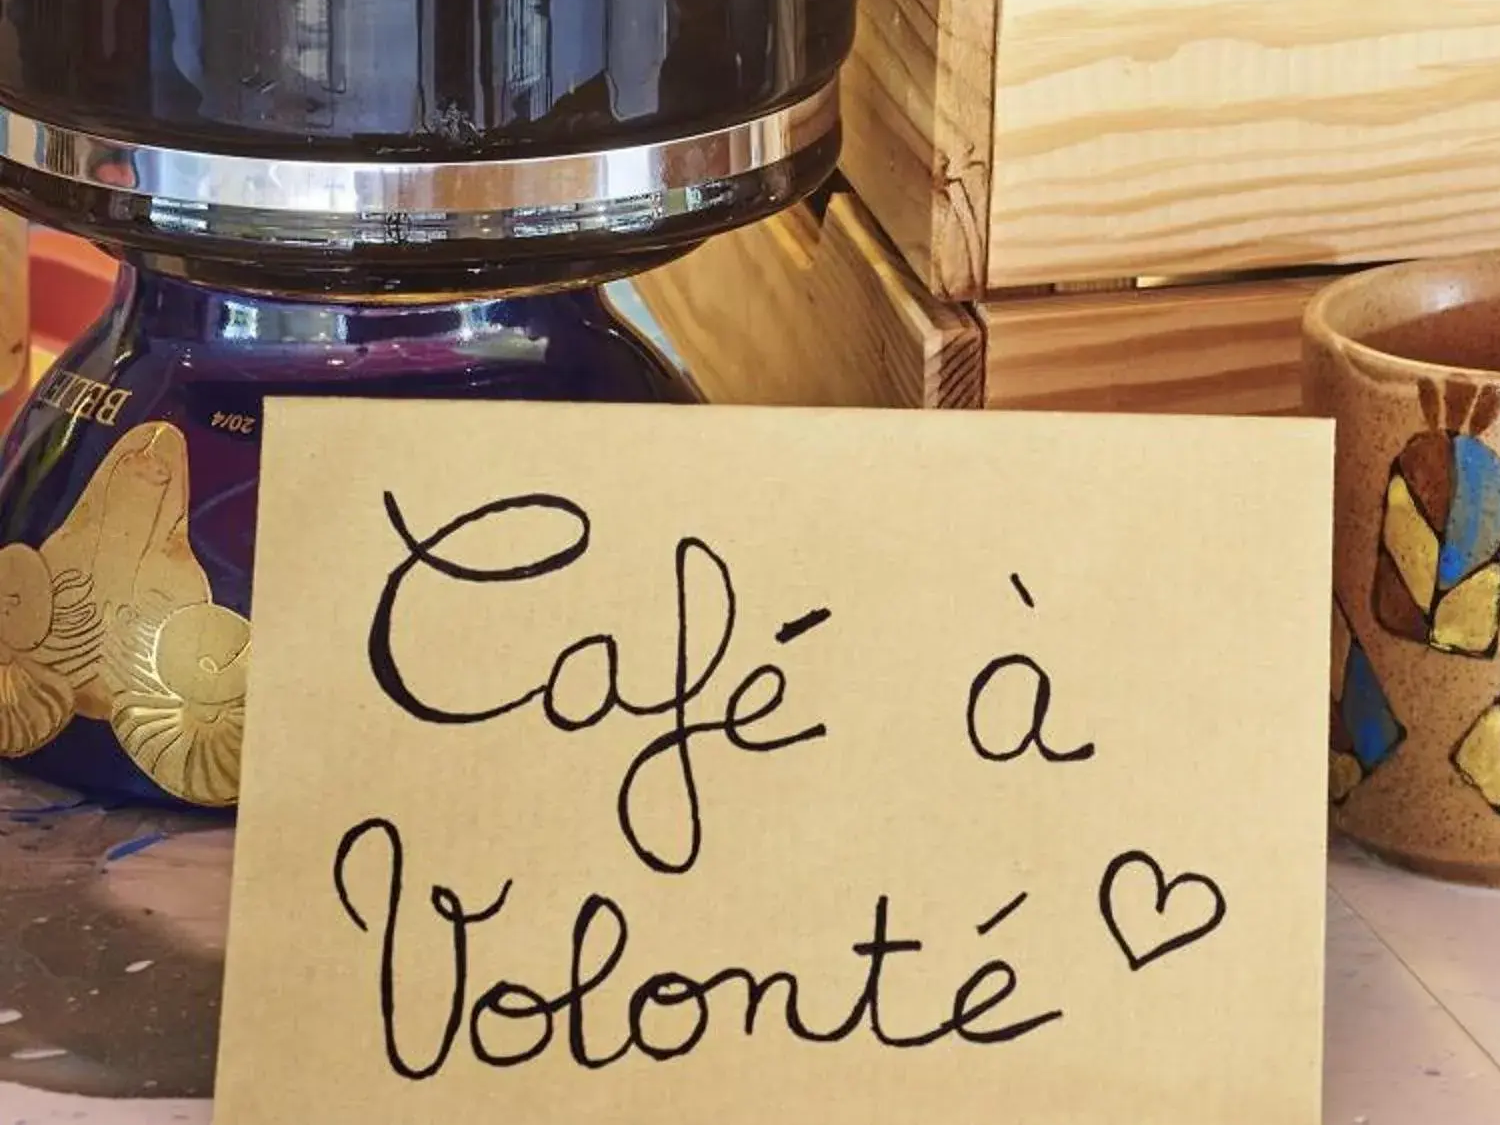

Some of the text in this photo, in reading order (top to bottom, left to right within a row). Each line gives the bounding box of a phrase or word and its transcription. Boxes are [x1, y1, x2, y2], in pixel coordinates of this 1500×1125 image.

[367, 490, 1095, 874] Café à
[333, 817, 1063, 1081] Volonté
